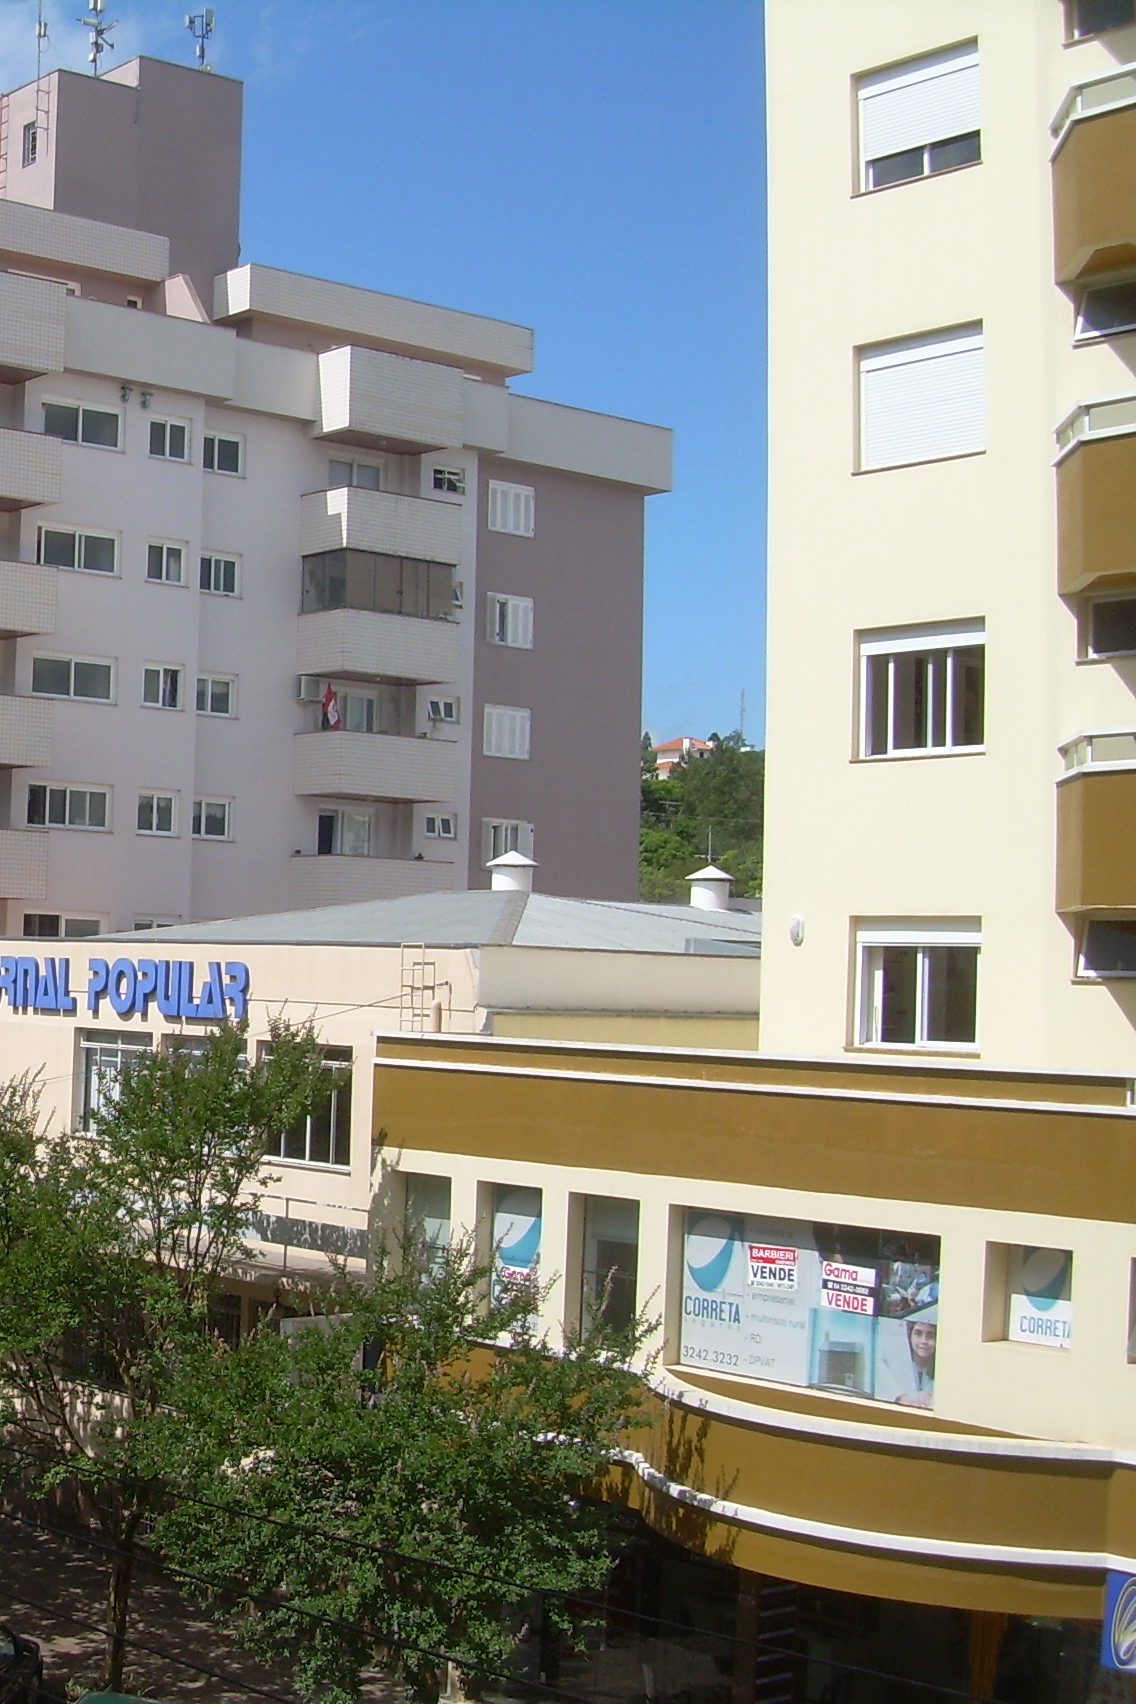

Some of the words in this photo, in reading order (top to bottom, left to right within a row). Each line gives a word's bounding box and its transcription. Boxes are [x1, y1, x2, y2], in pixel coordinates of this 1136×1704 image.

[87, 957, 250, 1019] POPULAR
[751, 1248, 795, 1261] BARBIERI
[751, 1264, 795, 1282] VENDE
[824, 1262, 859, 1282] Gama
[684, 1295, 741, 1325] CORRETA
[826, 1291, 869, 1313] VENDE
